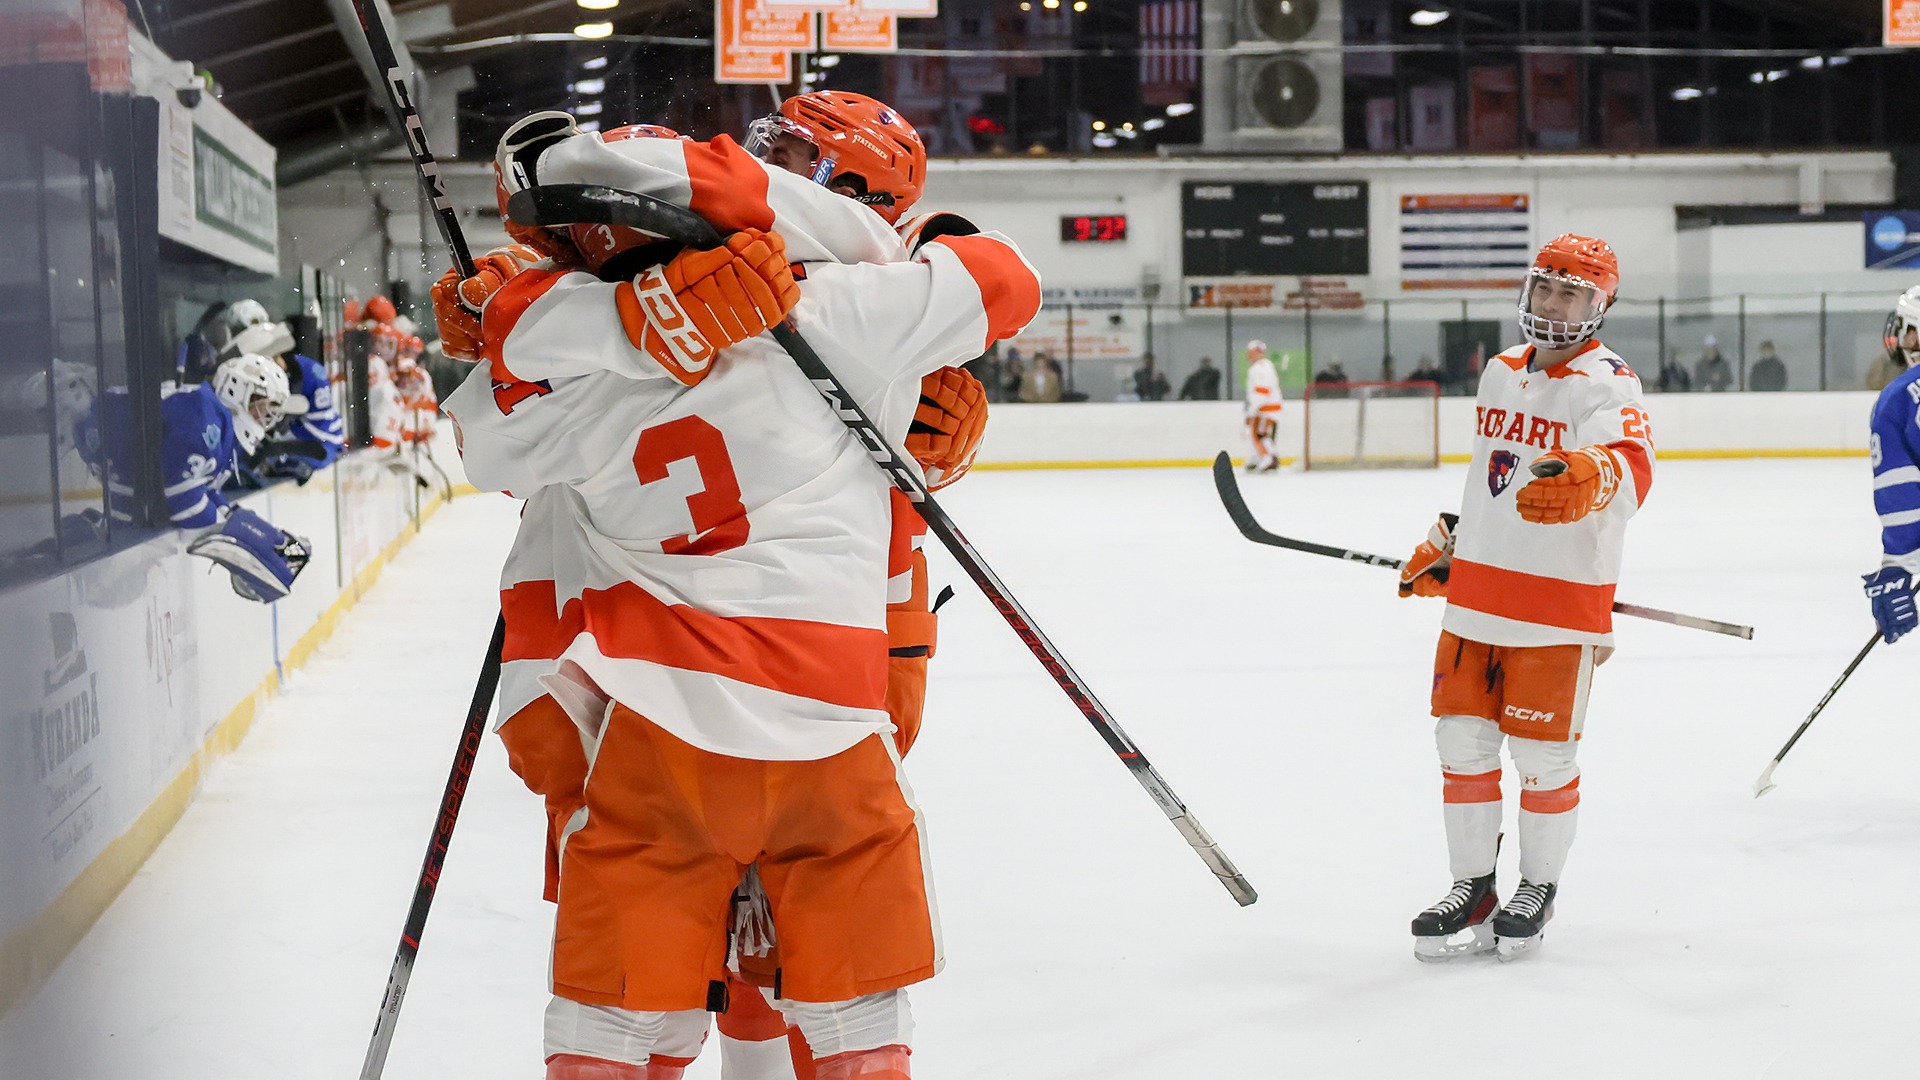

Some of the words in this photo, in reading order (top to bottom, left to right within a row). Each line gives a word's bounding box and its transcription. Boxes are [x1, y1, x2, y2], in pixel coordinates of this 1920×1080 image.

[388, 66, 453, 210] CCM
[598, 224, 616, 251] 3
[632, 413, 751, 557] 3
[810, 378, 925, 503] CCM
[993, 596, 1106, 724] JETSPEED
[1504, 704, 1555, 723] CCM
[422, 730, 481, 901] JETSPEED
